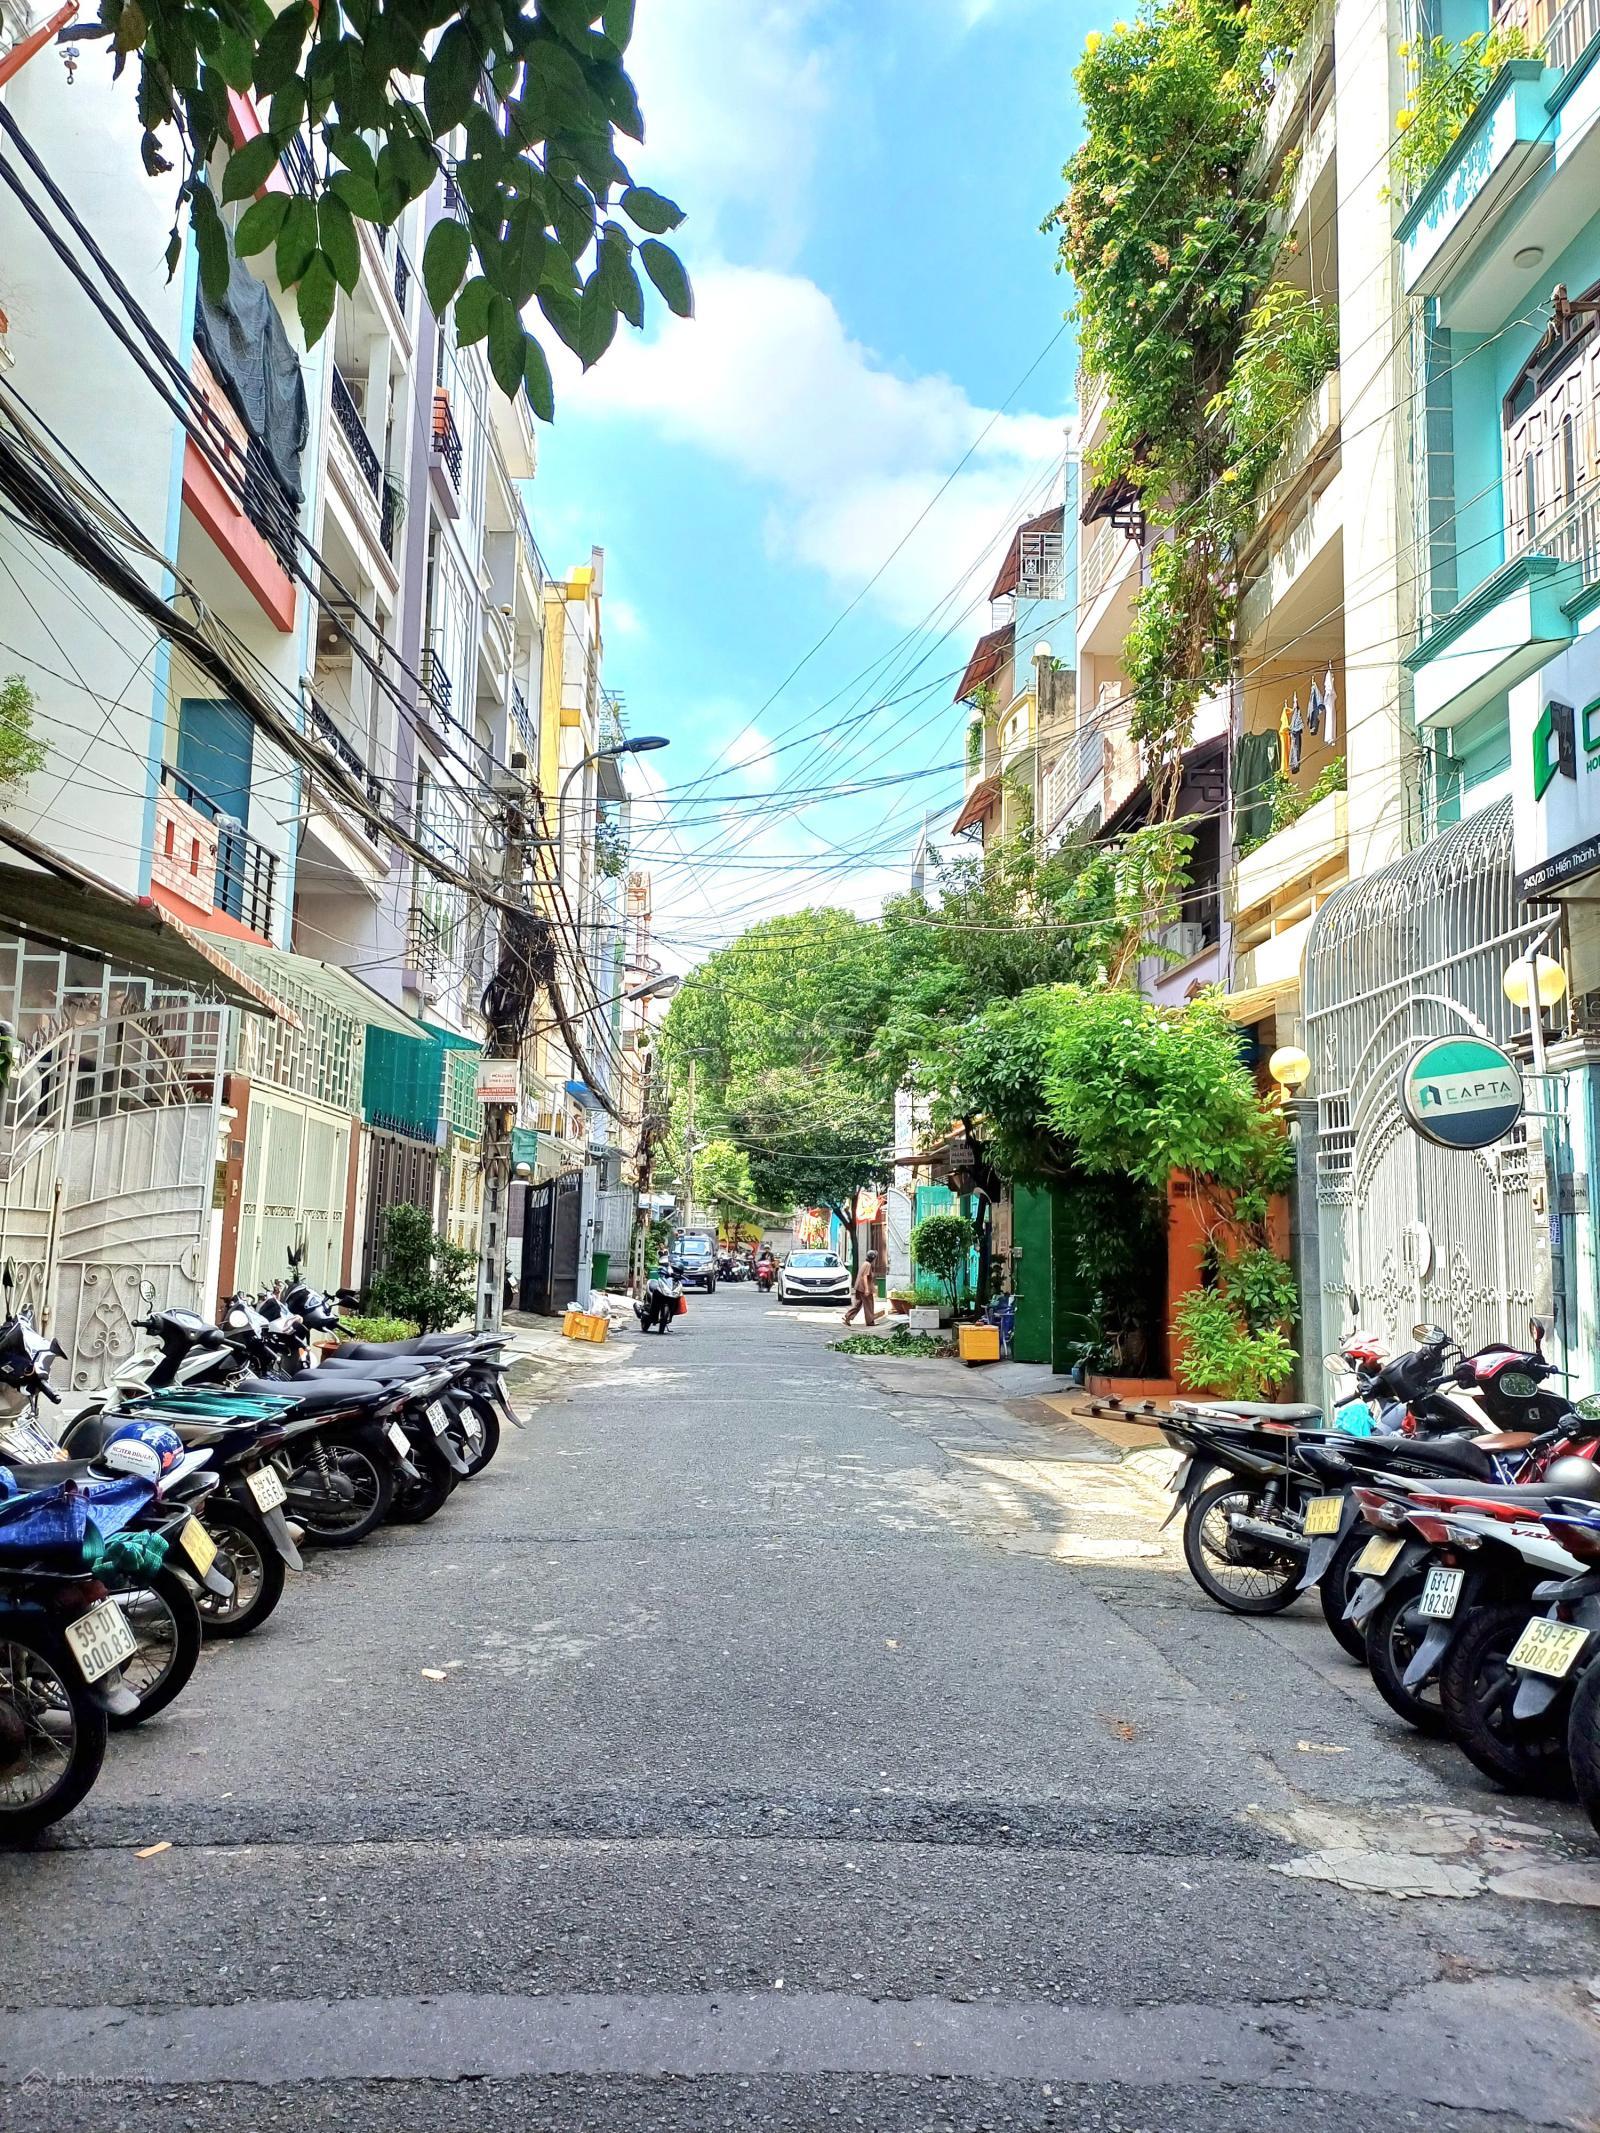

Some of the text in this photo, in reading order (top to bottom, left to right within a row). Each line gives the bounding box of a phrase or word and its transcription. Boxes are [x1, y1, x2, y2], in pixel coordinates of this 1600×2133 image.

[1586, 754, 1600, 775] HO
[1524, 870, 1546, 891] 243/20
[1446, 1081, 1512, 1100] CAPTA
[1430, 1572, 1457, 1593] 63-C1
[1422, 1592, 1455, 1615] 182.98
[74, 1607, 116, 1648] 59-D1
[1531, 1622, 1578, 1651] 59-F2
[82, 1627, 132, 1676] 900.83
[1515, 1642, 1569, 1672] 308.89
